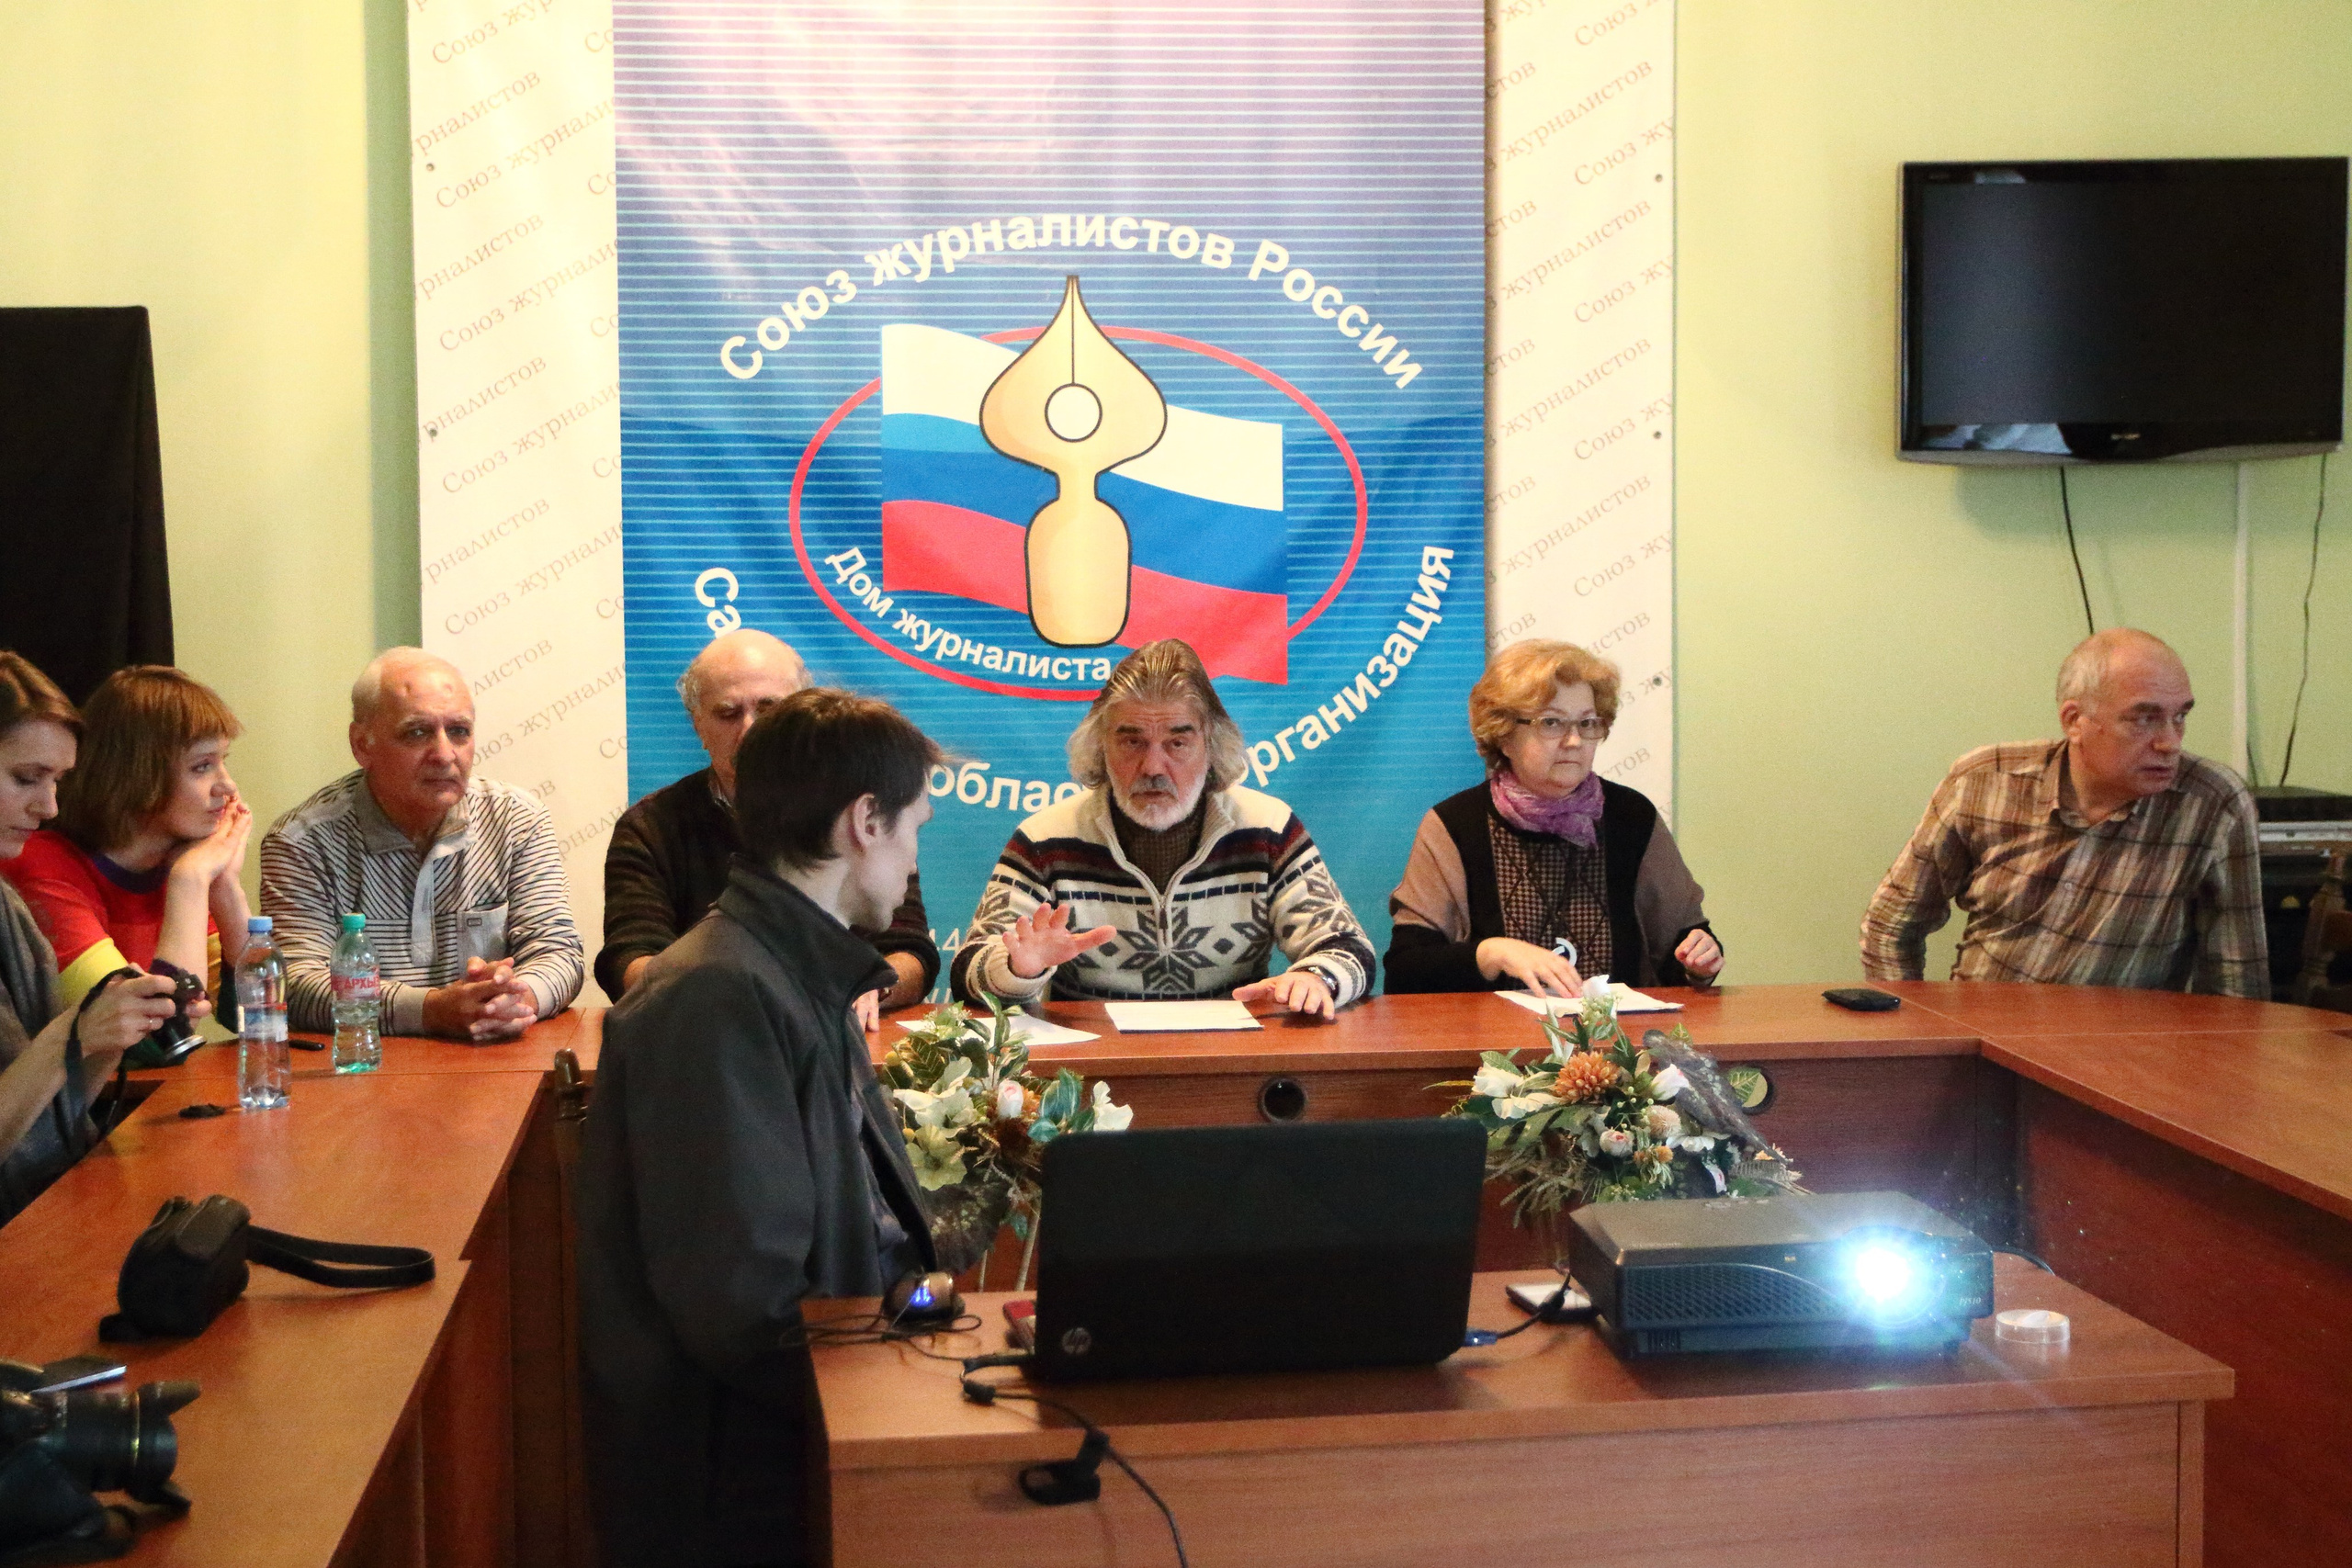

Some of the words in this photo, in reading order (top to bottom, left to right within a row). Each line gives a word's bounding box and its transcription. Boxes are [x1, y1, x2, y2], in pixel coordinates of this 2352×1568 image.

[433, 20, 498, 63] Союз
[1575, 2, 1638, 46] Союз
[1500, 61, 1652, 162] журналистов
[1575, 142, 1637, 184] Союз
[436, 164, 502, 208] Союз
[1500, 200, 1651, 299] журналистов
[720, 269, 858, 380] Союз
[864, 213, 1236, 286] журналистов
[1248, 238, 1423, 389] России
[1575, 281, 1636, 322] Союз
[439, 308, 505, 351] Союз
[1500, 338, 1651, 437] журналистов
[1574, 418, 1636, 460] Союз
[443, 450, 508, 493] Союз
[1500, 475, 1651, 576] журналистов
[1574, 554, 1636, 597] Союз
[445, 592, 511, 636] Союз
[824, 547, 894, 618] Дом
[892, 606, 1111, 682] журналиста
